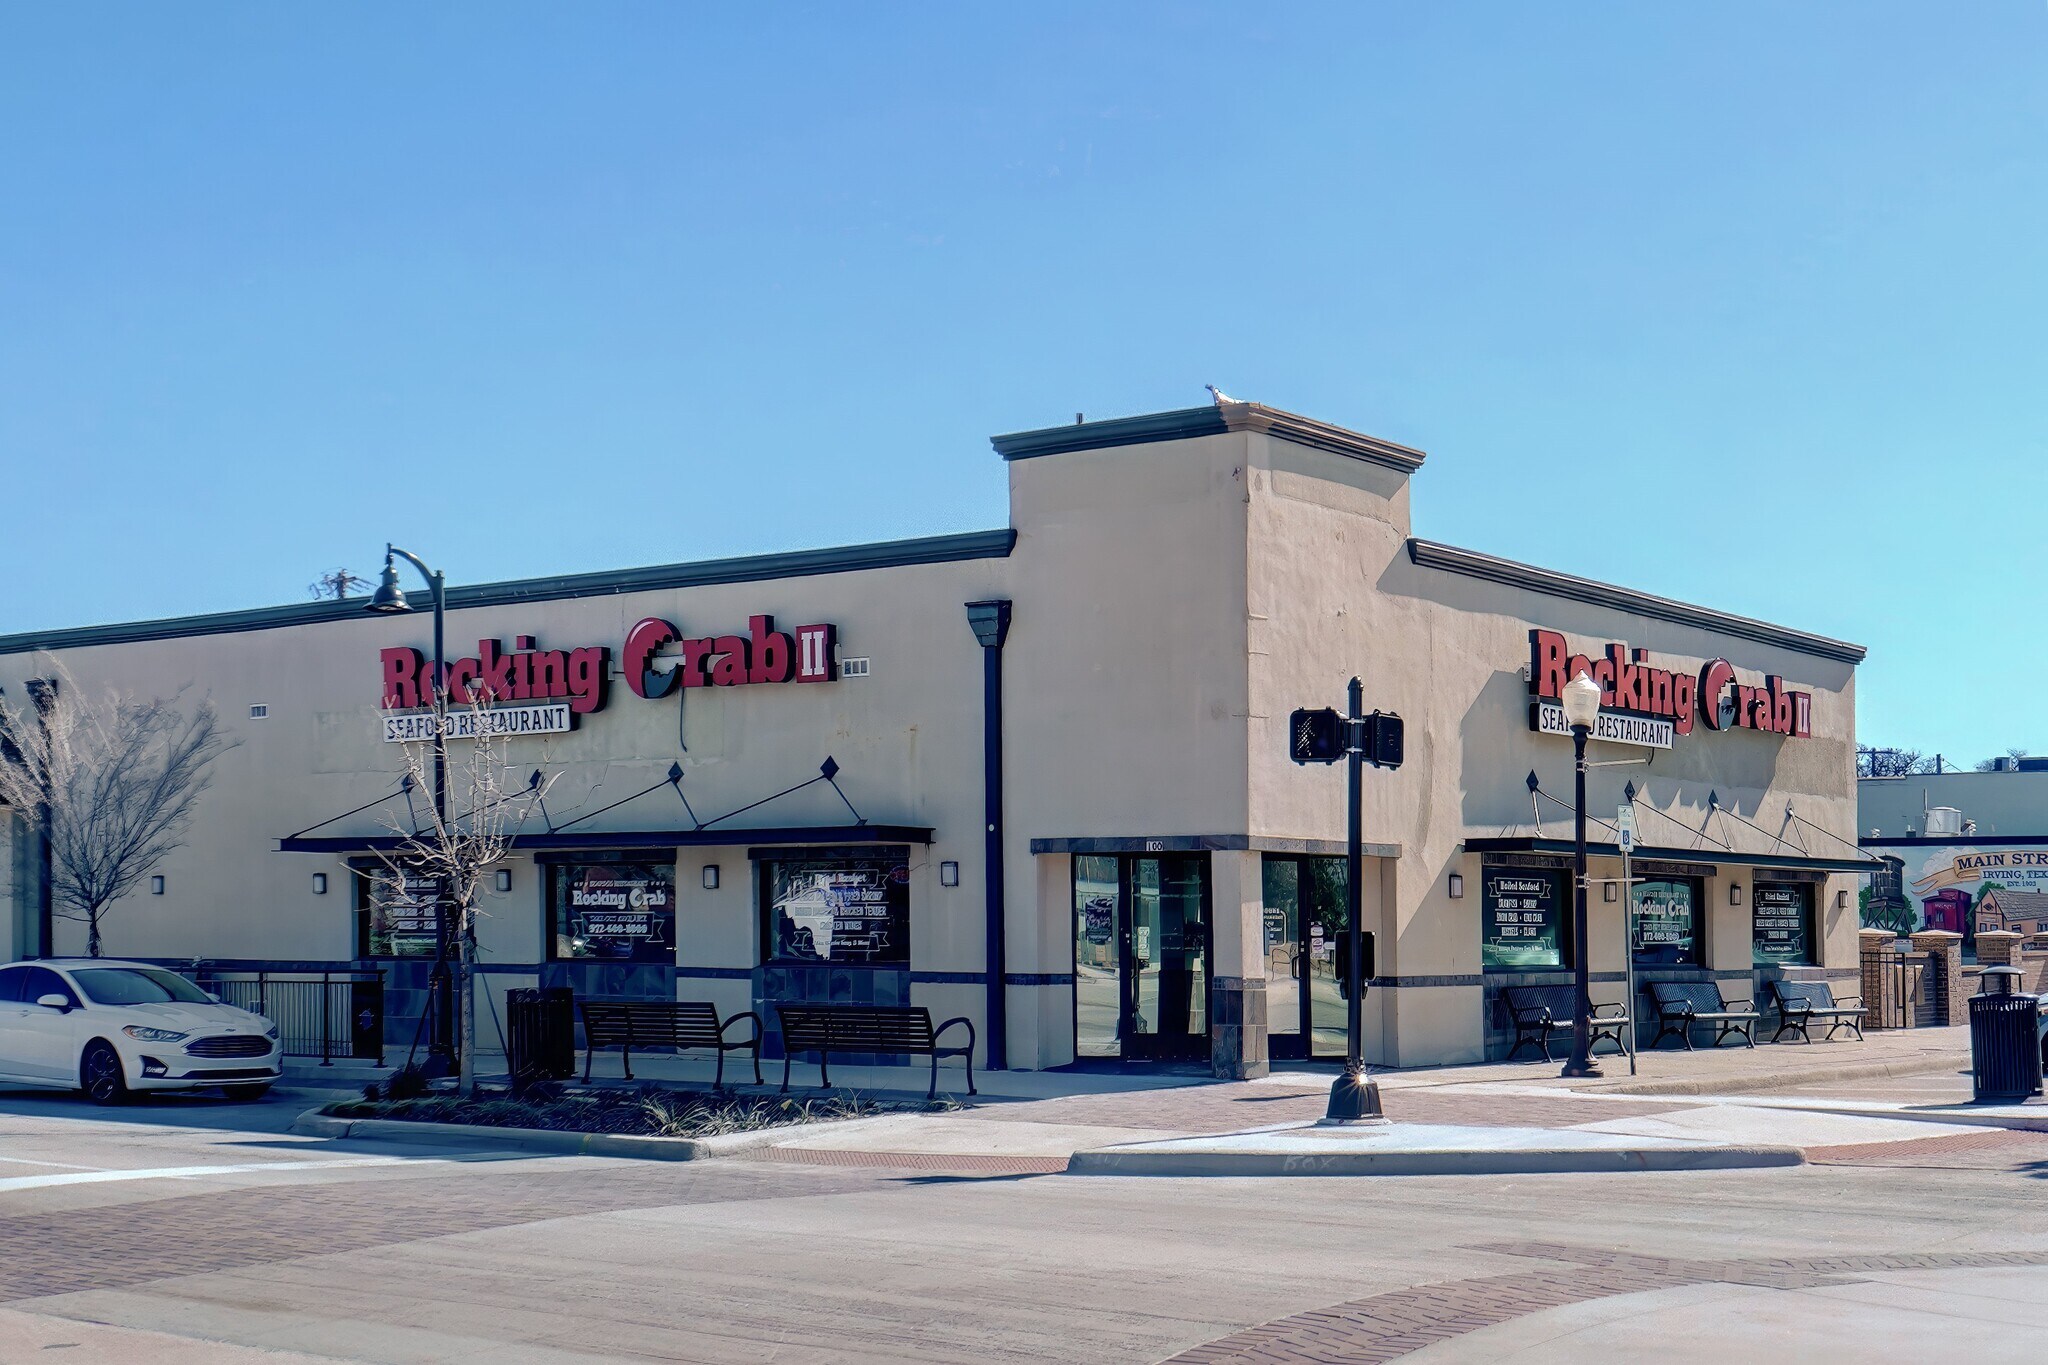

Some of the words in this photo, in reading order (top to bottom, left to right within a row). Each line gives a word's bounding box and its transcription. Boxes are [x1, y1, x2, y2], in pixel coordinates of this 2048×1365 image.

[381, 636, 608, 713] Rocking
[623, 615, 795, 698] Crab
[1699, 656, 1793, 735] Crab
[387, 715, 454, 739] SEAFOD
[1598, 715, 1671, 745] RESTAURANT
[1957, 854, 2006, 869] MAIN
[2012, 853, 2048, 865] STR
[1983, 870, 2024, 880] IRVING,
[572, 890, 627, 909] Rocking
[629, 887, 666, 908] Crab
[1633, 900, 1666, 918] Rocking
[1668, 900, 1689, 917] Crab
